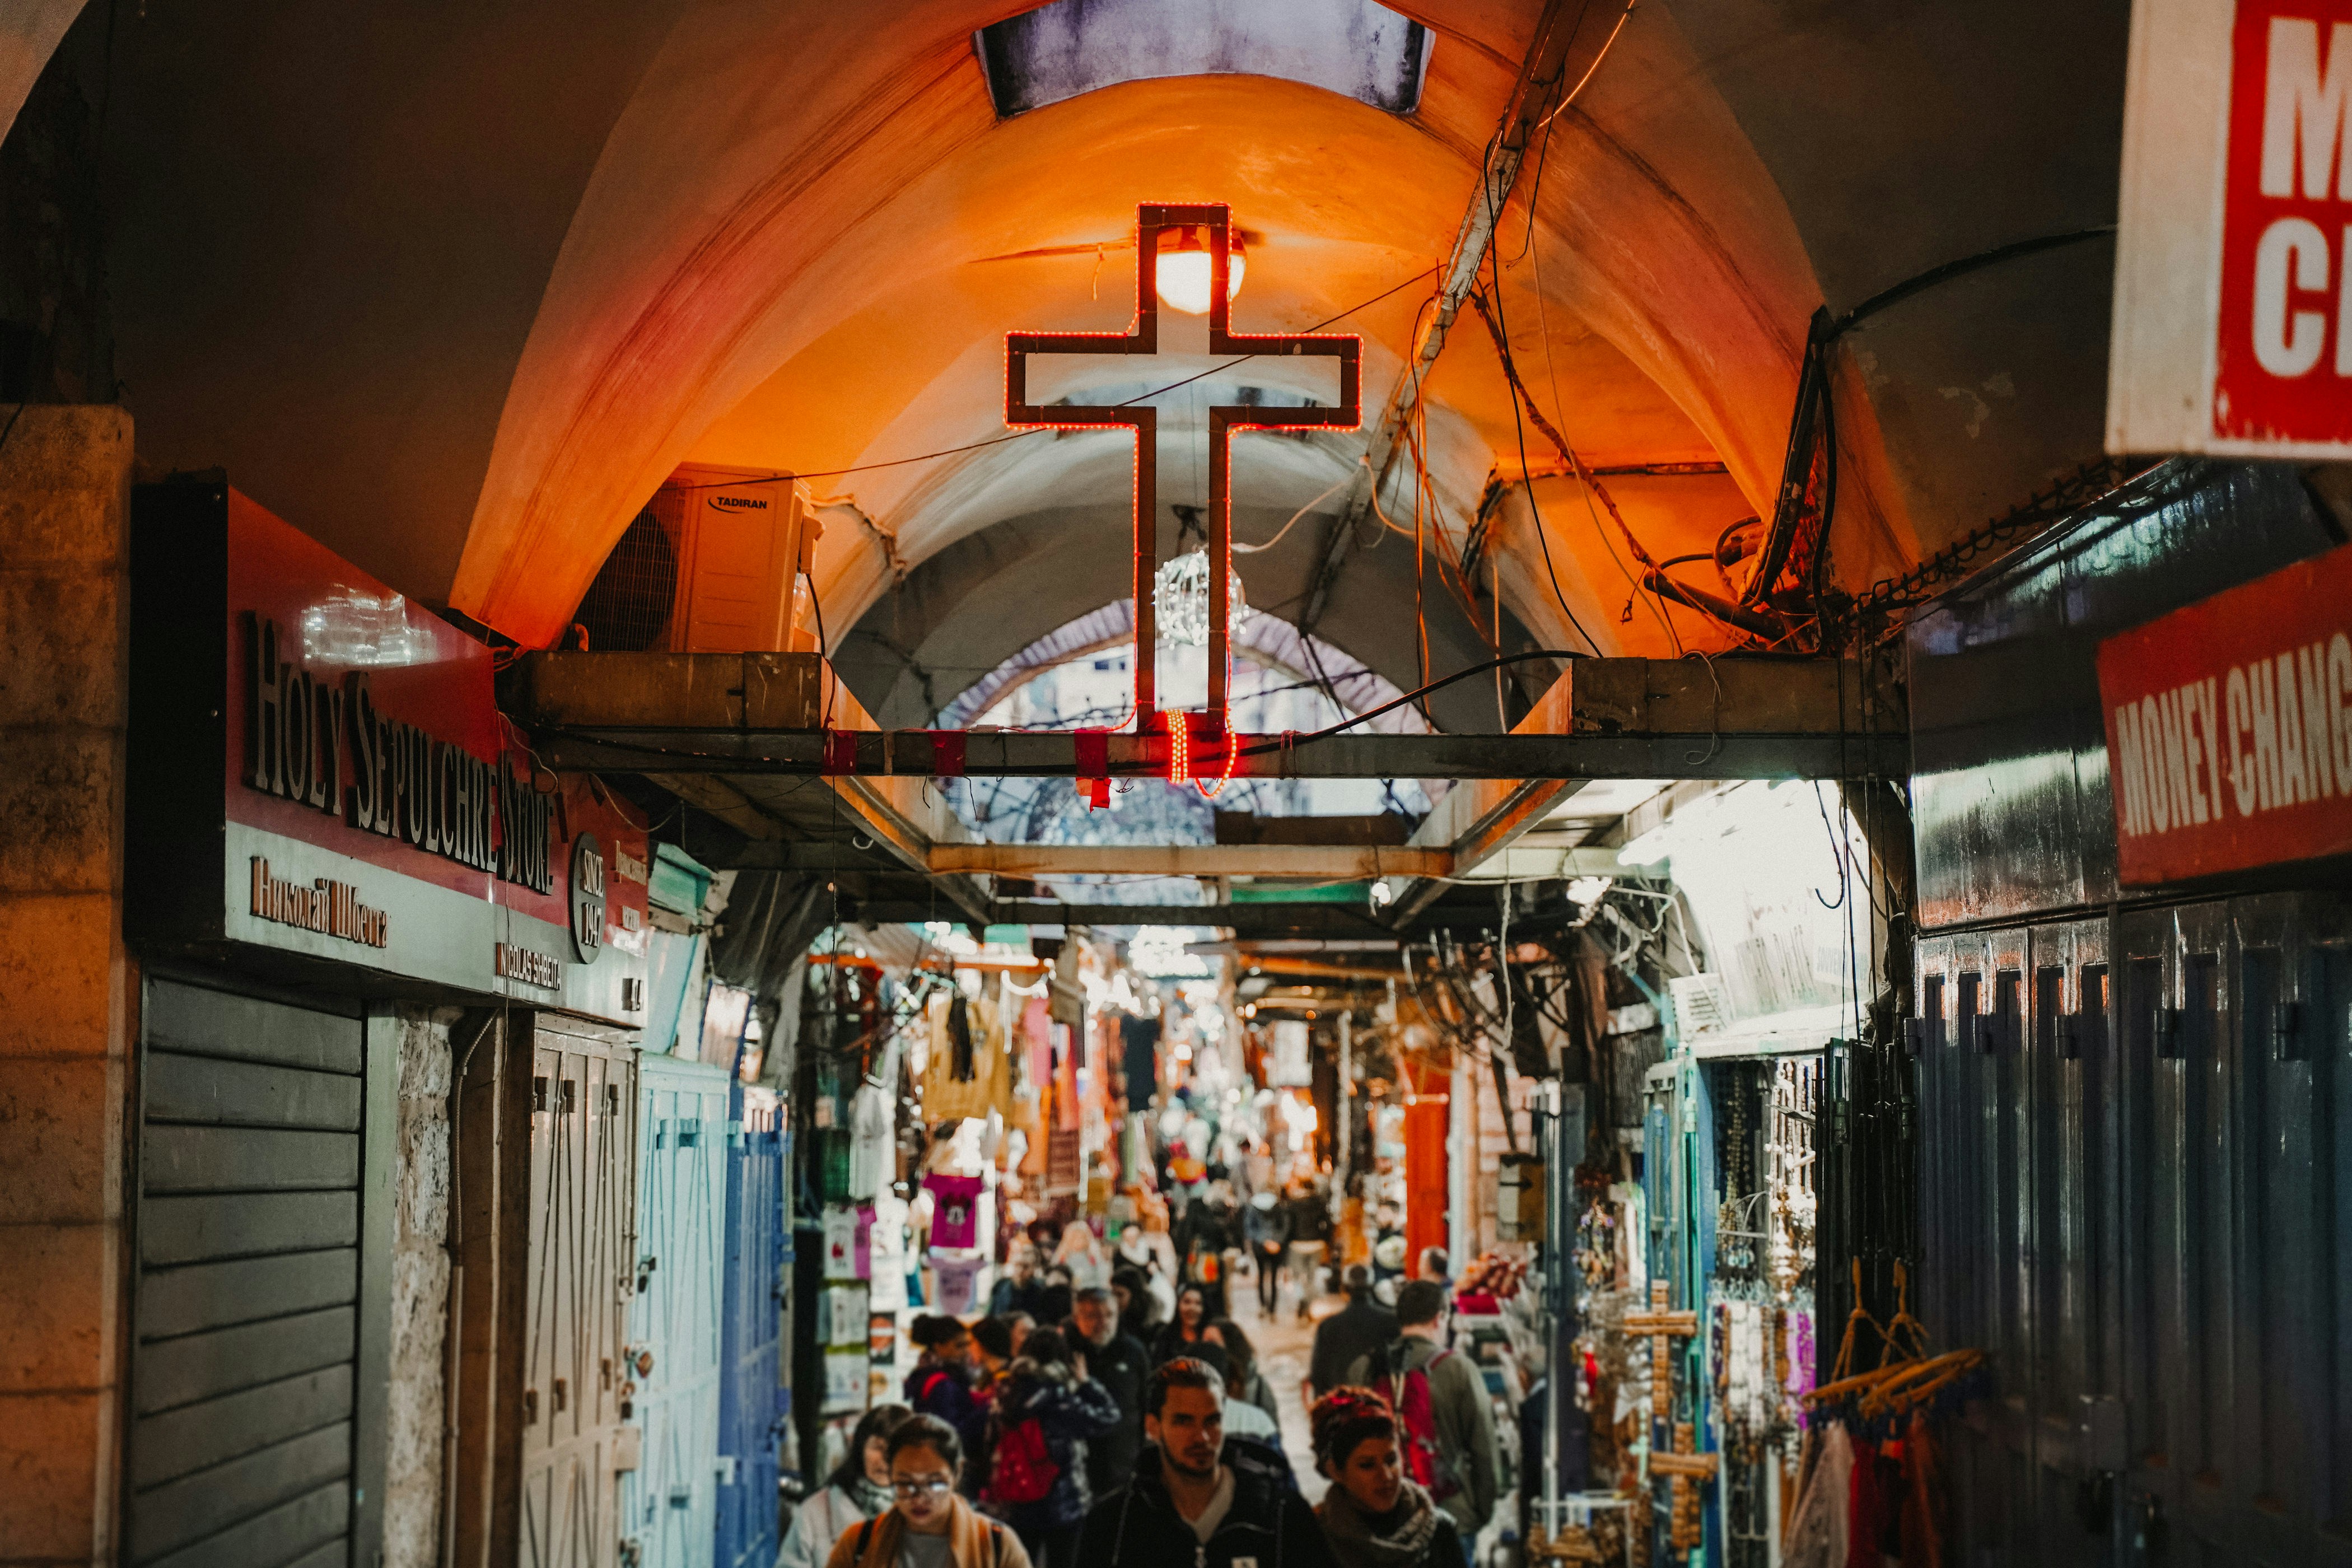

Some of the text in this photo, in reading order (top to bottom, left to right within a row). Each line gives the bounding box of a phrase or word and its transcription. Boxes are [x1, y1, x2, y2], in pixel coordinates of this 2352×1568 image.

[2251, 214, 2352, 381] C
[716, 497, 767, 509] TADIRAN
[255, 619, 554, 895] HOLY SEPULCHRE STORE
[2115, 631, 2352, 838] MONEY CHANG
[259, 857, 330, 934] Николай
[584, 848, 604, 898] SINCE
[585, 902, 602, 948] 1947
[533, 951, 561, 991] SHBEITA
